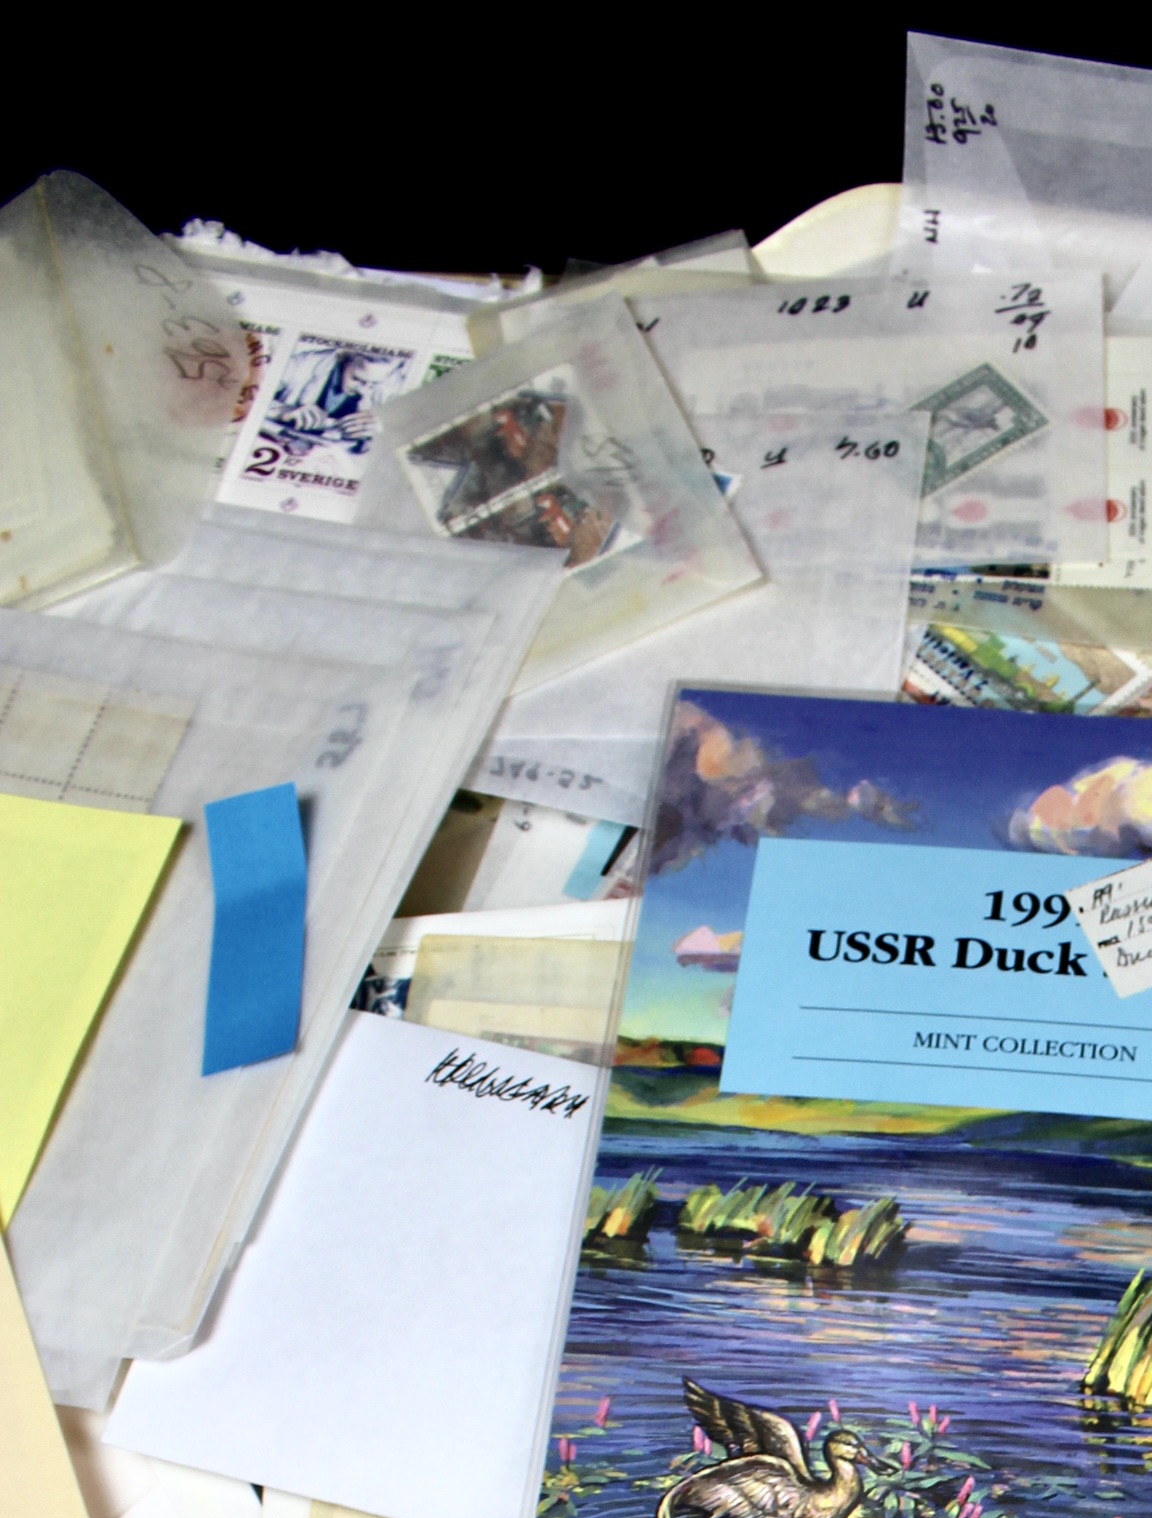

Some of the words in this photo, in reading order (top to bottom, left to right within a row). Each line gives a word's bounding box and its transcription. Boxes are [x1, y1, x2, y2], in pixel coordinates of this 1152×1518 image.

[244, 446, 281, 477] 2
[276, 467, 361, 492] SVERIGE
[983, 889, 1081, 930] 199
[807, 928, 936, 967] USSR
[951, 936, 1088, 977] Duck
[912, 1030, 978, 1053] MINT
[982, 1034, 1138, 1063] COLLECTION
